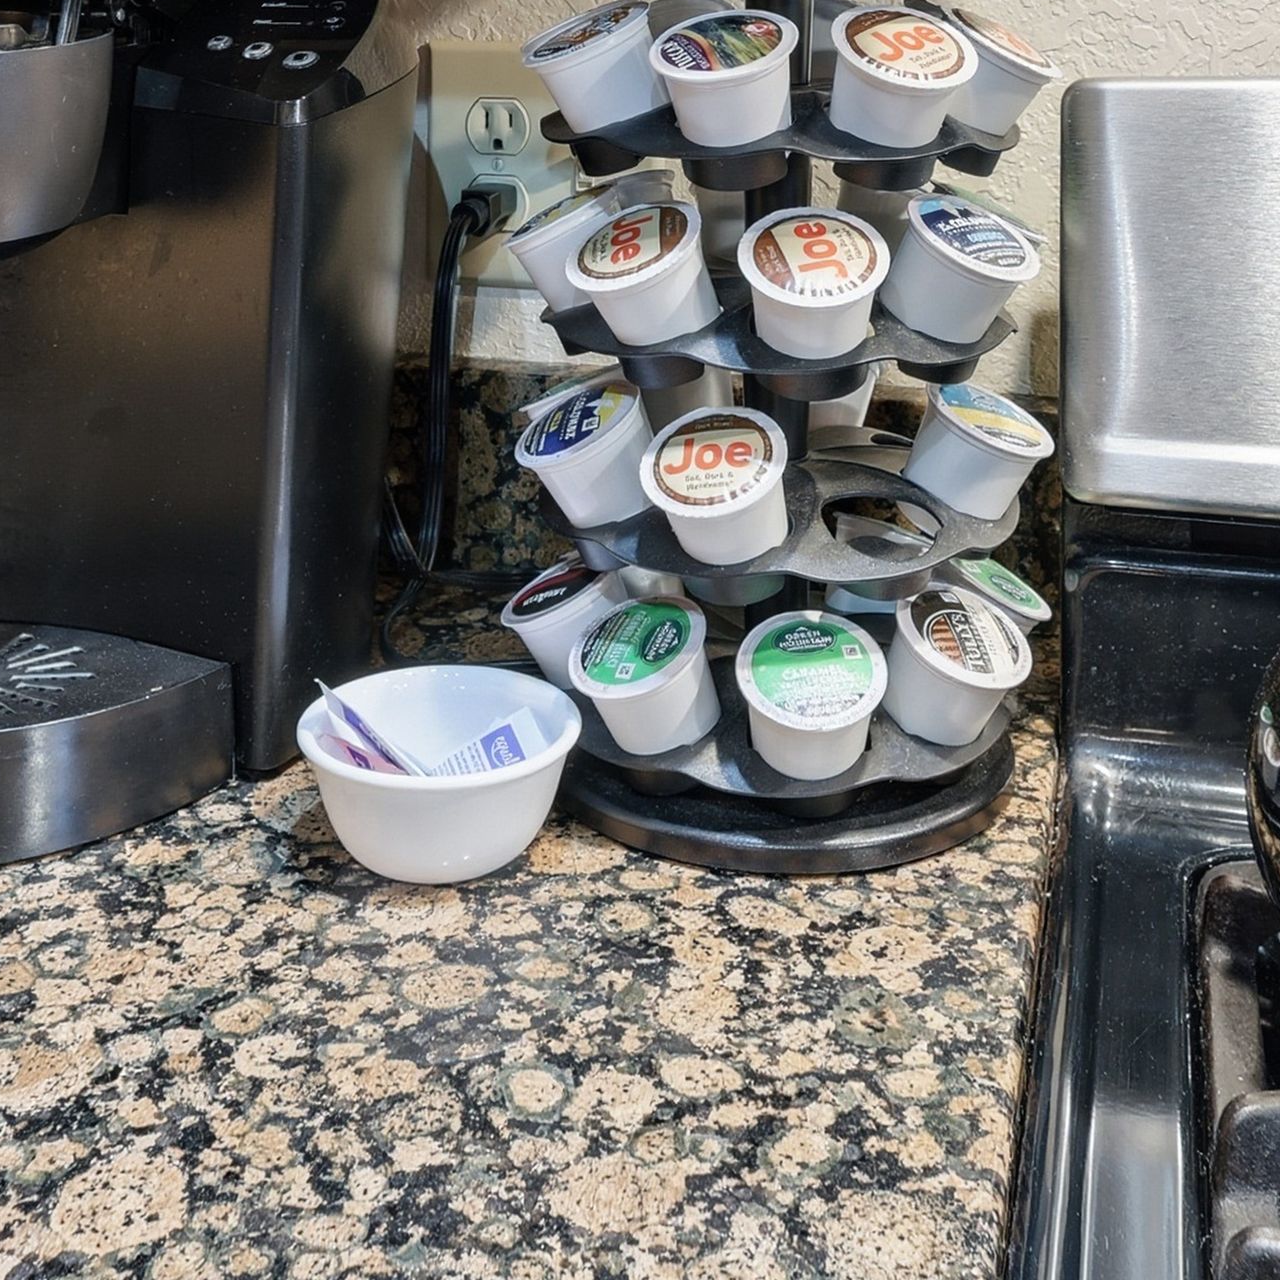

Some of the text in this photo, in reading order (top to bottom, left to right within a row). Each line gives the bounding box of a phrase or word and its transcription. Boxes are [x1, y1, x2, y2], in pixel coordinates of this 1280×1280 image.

[871, 25, 945, 61] Joe
[610, 214, 654, 265] Joe
[794, 222, 849, 278] Joe
[663, 438, 753, 476] Joe
